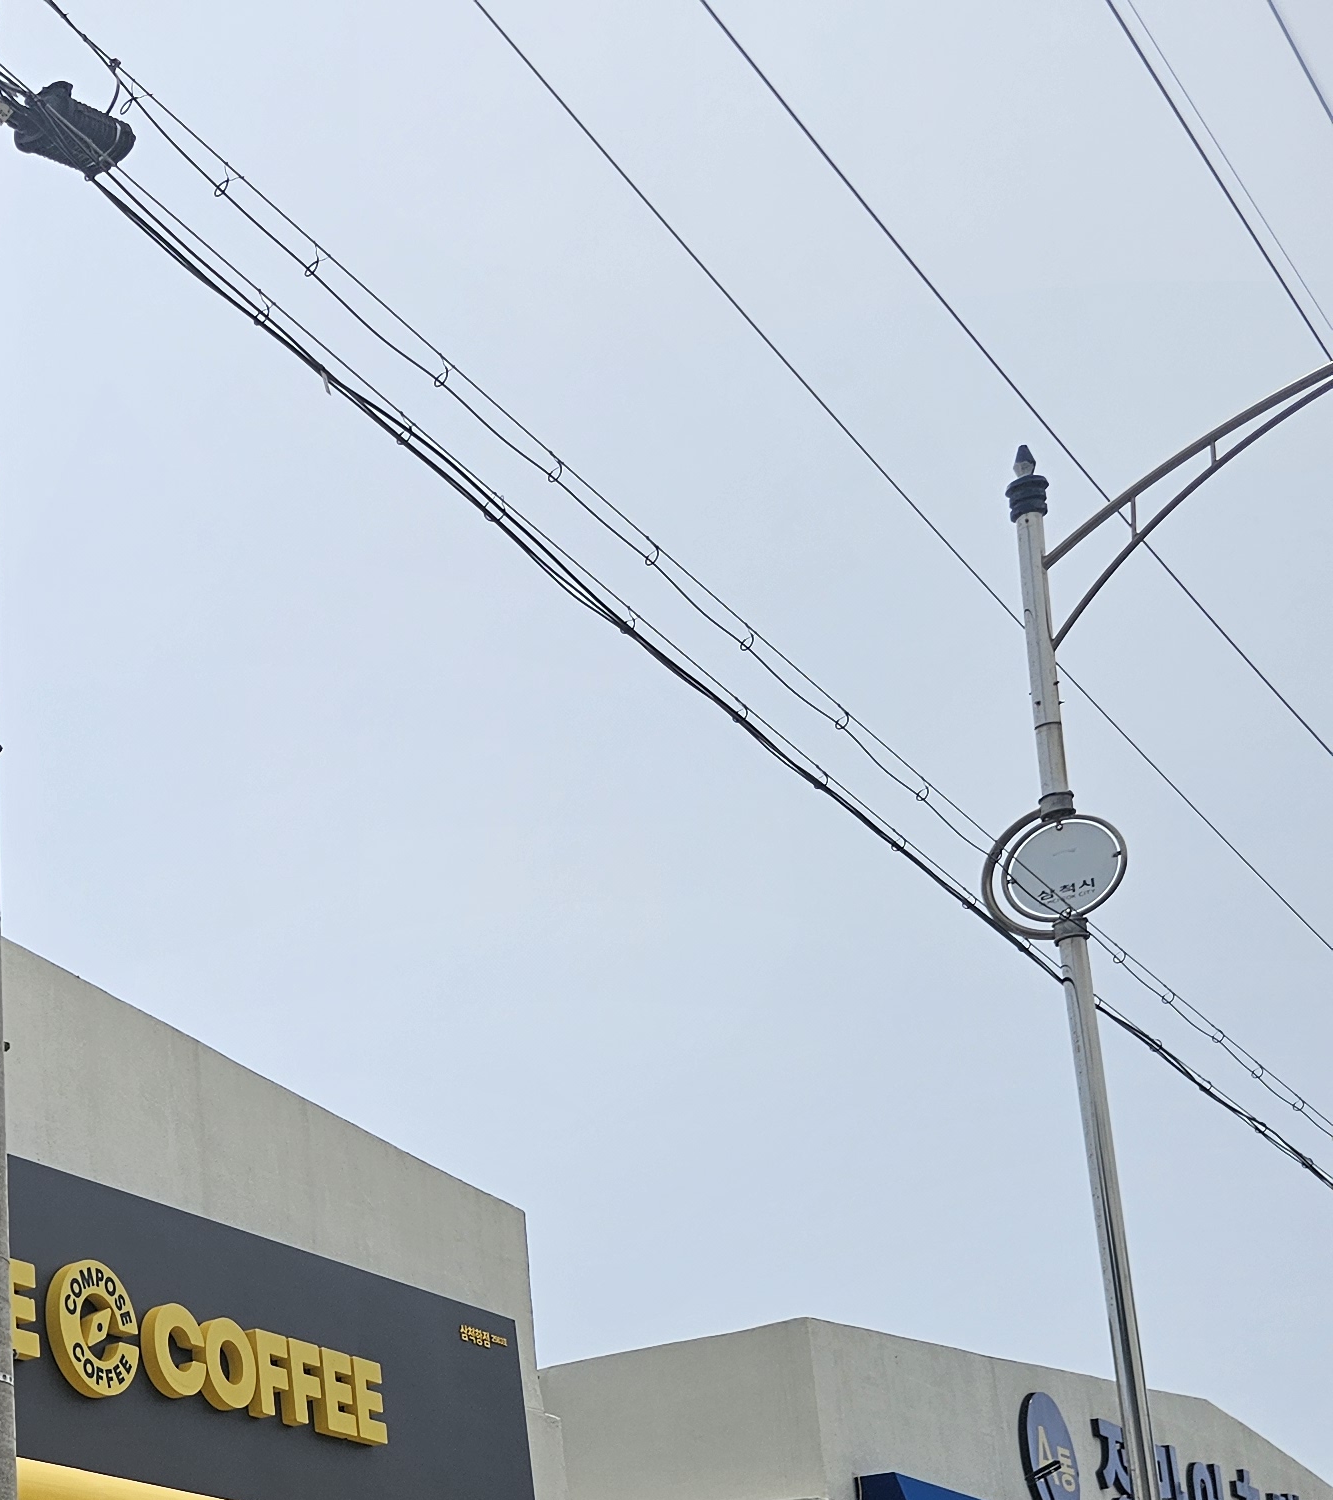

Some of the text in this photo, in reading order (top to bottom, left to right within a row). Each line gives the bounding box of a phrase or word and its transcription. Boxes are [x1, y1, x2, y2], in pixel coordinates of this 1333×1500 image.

[64, 1267, 134, 1328] COMPOSE
[72, 1340, 133, 1389] COFFEE
[140, 1302, 389, 1447] COFFEE
